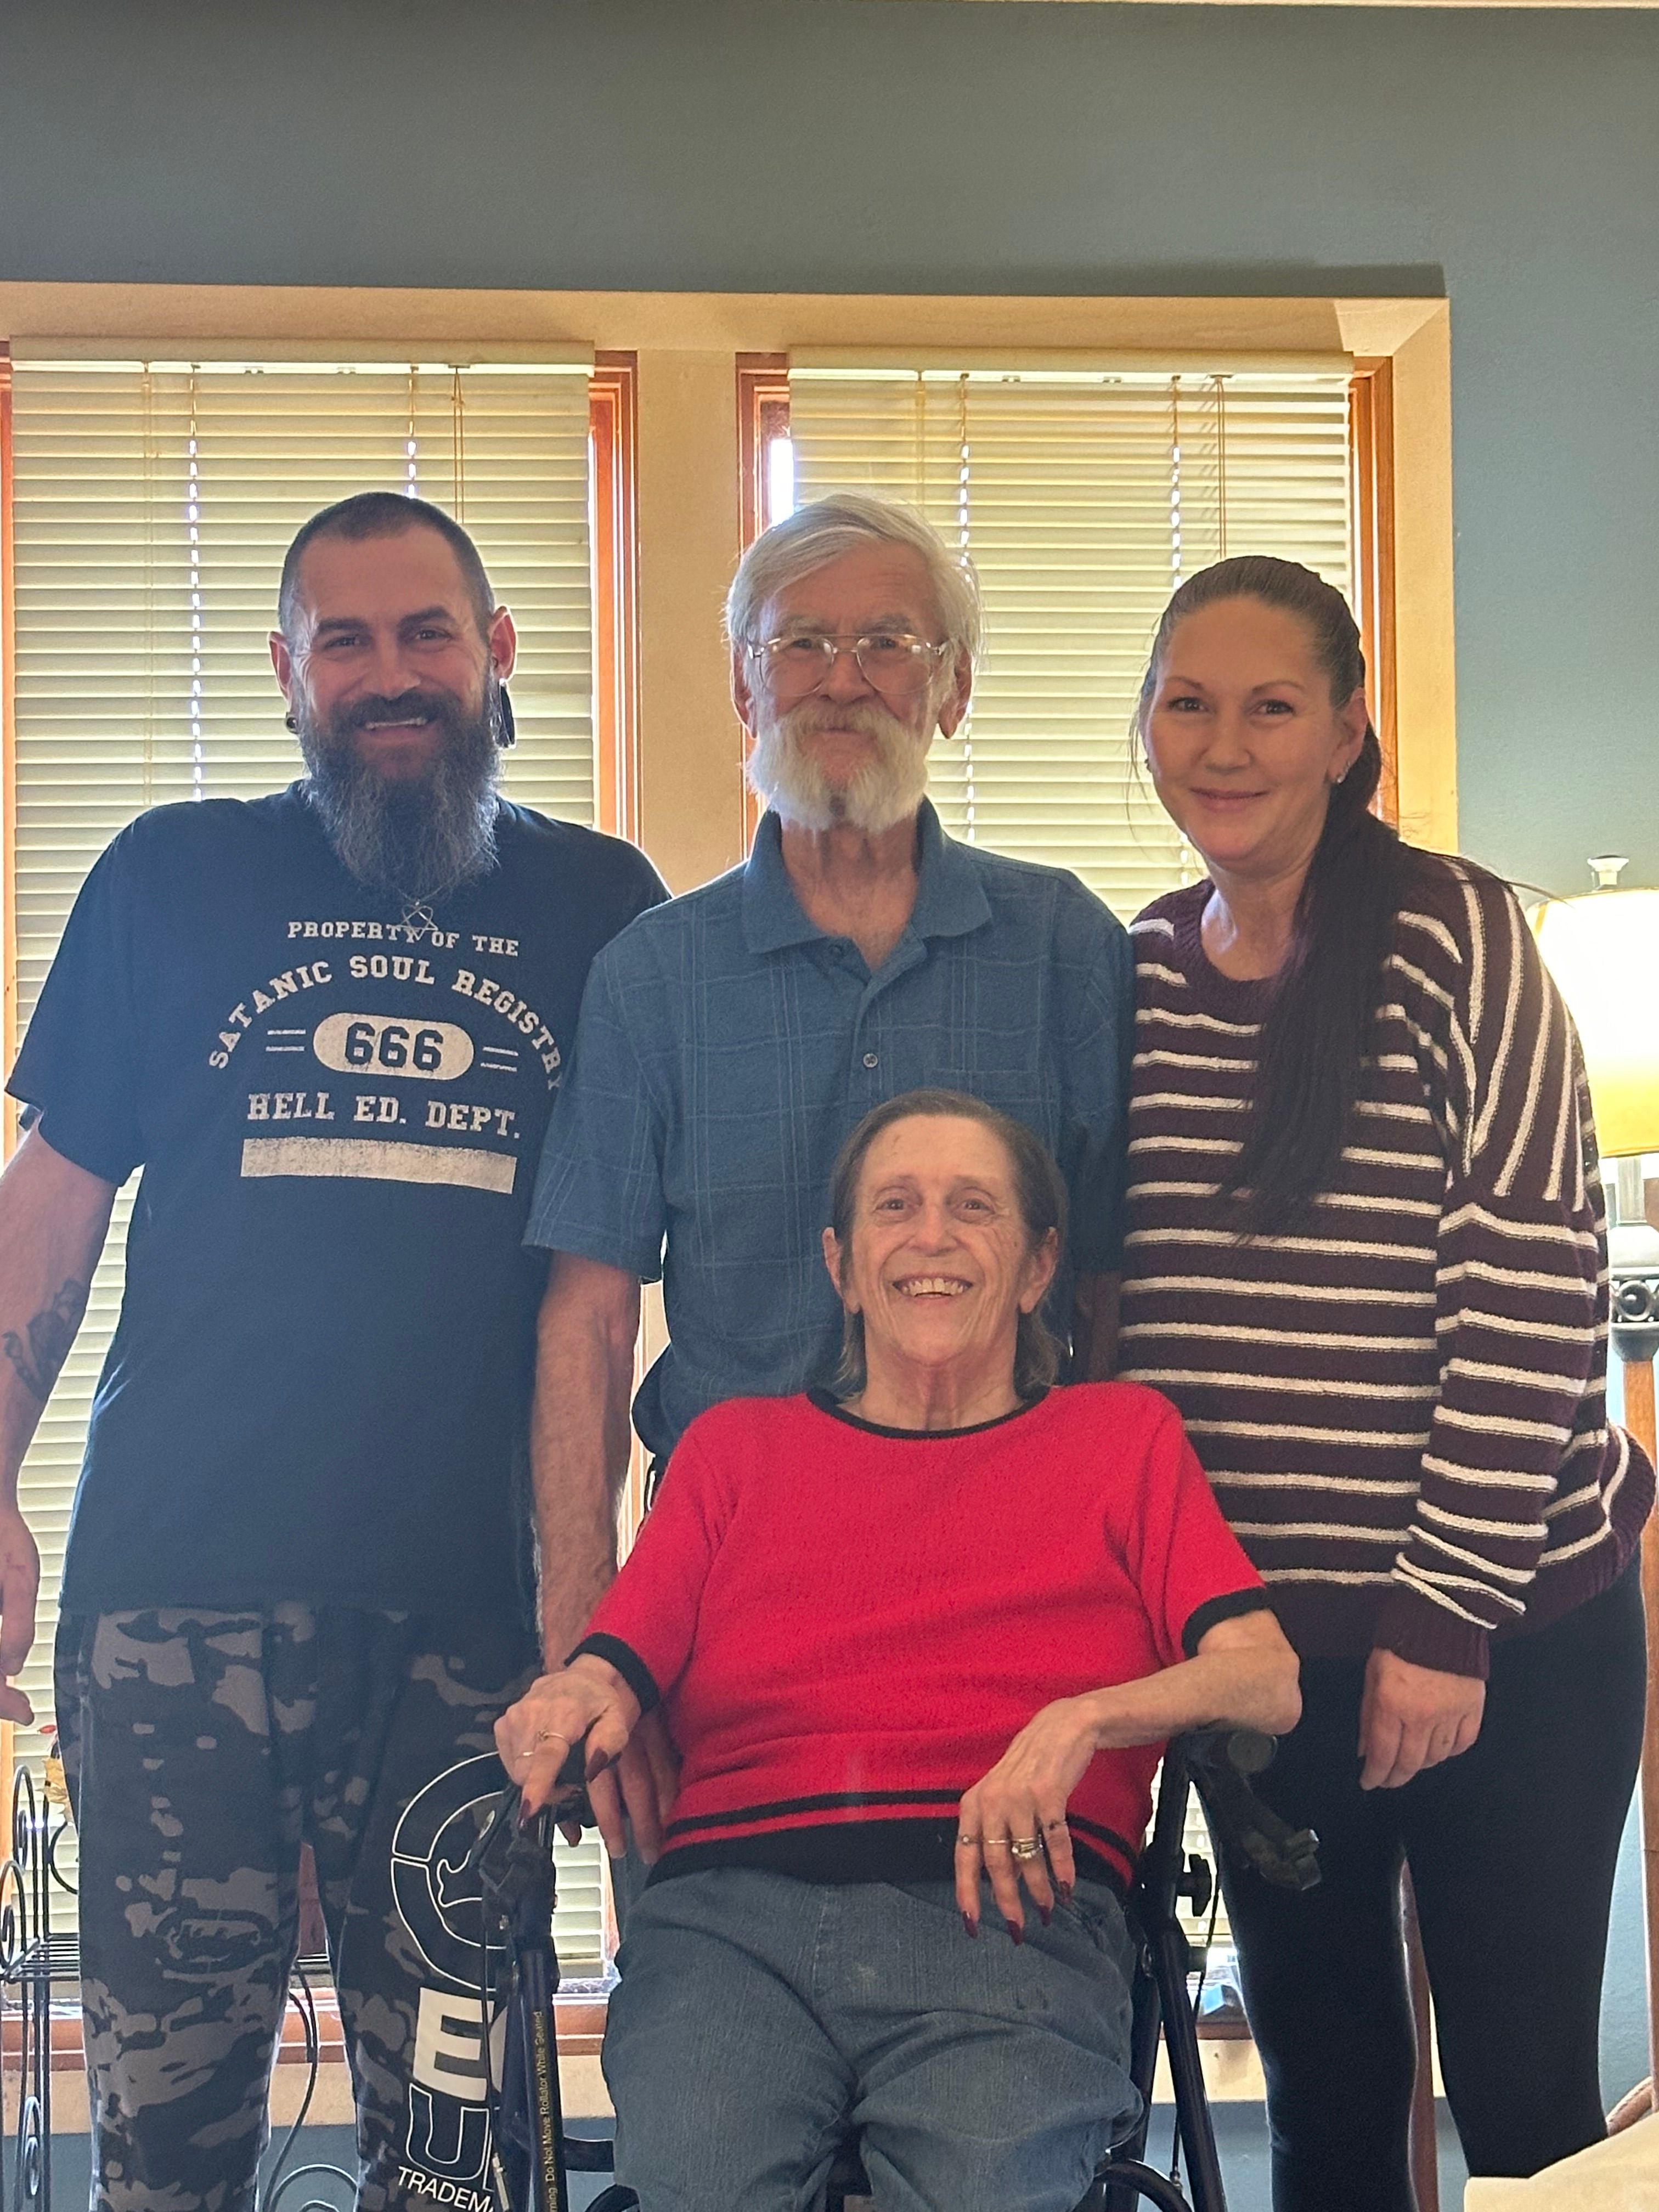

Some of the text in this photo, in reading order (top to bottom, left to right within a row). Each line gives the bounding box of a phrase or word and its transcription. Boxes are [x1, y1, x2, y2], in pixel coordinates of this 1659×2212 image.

[287, 922, 519, 956] PROPERTY OF THE
[208, 961, 332, 1069] SATANIC
[349, 955, 435, 985] SOUL
[344, 1022, 443, 1072] 666
[247, 1092, 521, 1139] HELL ED. DEPT.
[535, 2047, 546, 2076] While
[539, 2077, 551, 2115] Rollator
[541, 2116, 552, 2145] Move
[543, 2146, 554, 2165] Not
[398, 2166, 495, 2212] TRADEM
[545, 2166, 555, 2182] Do
